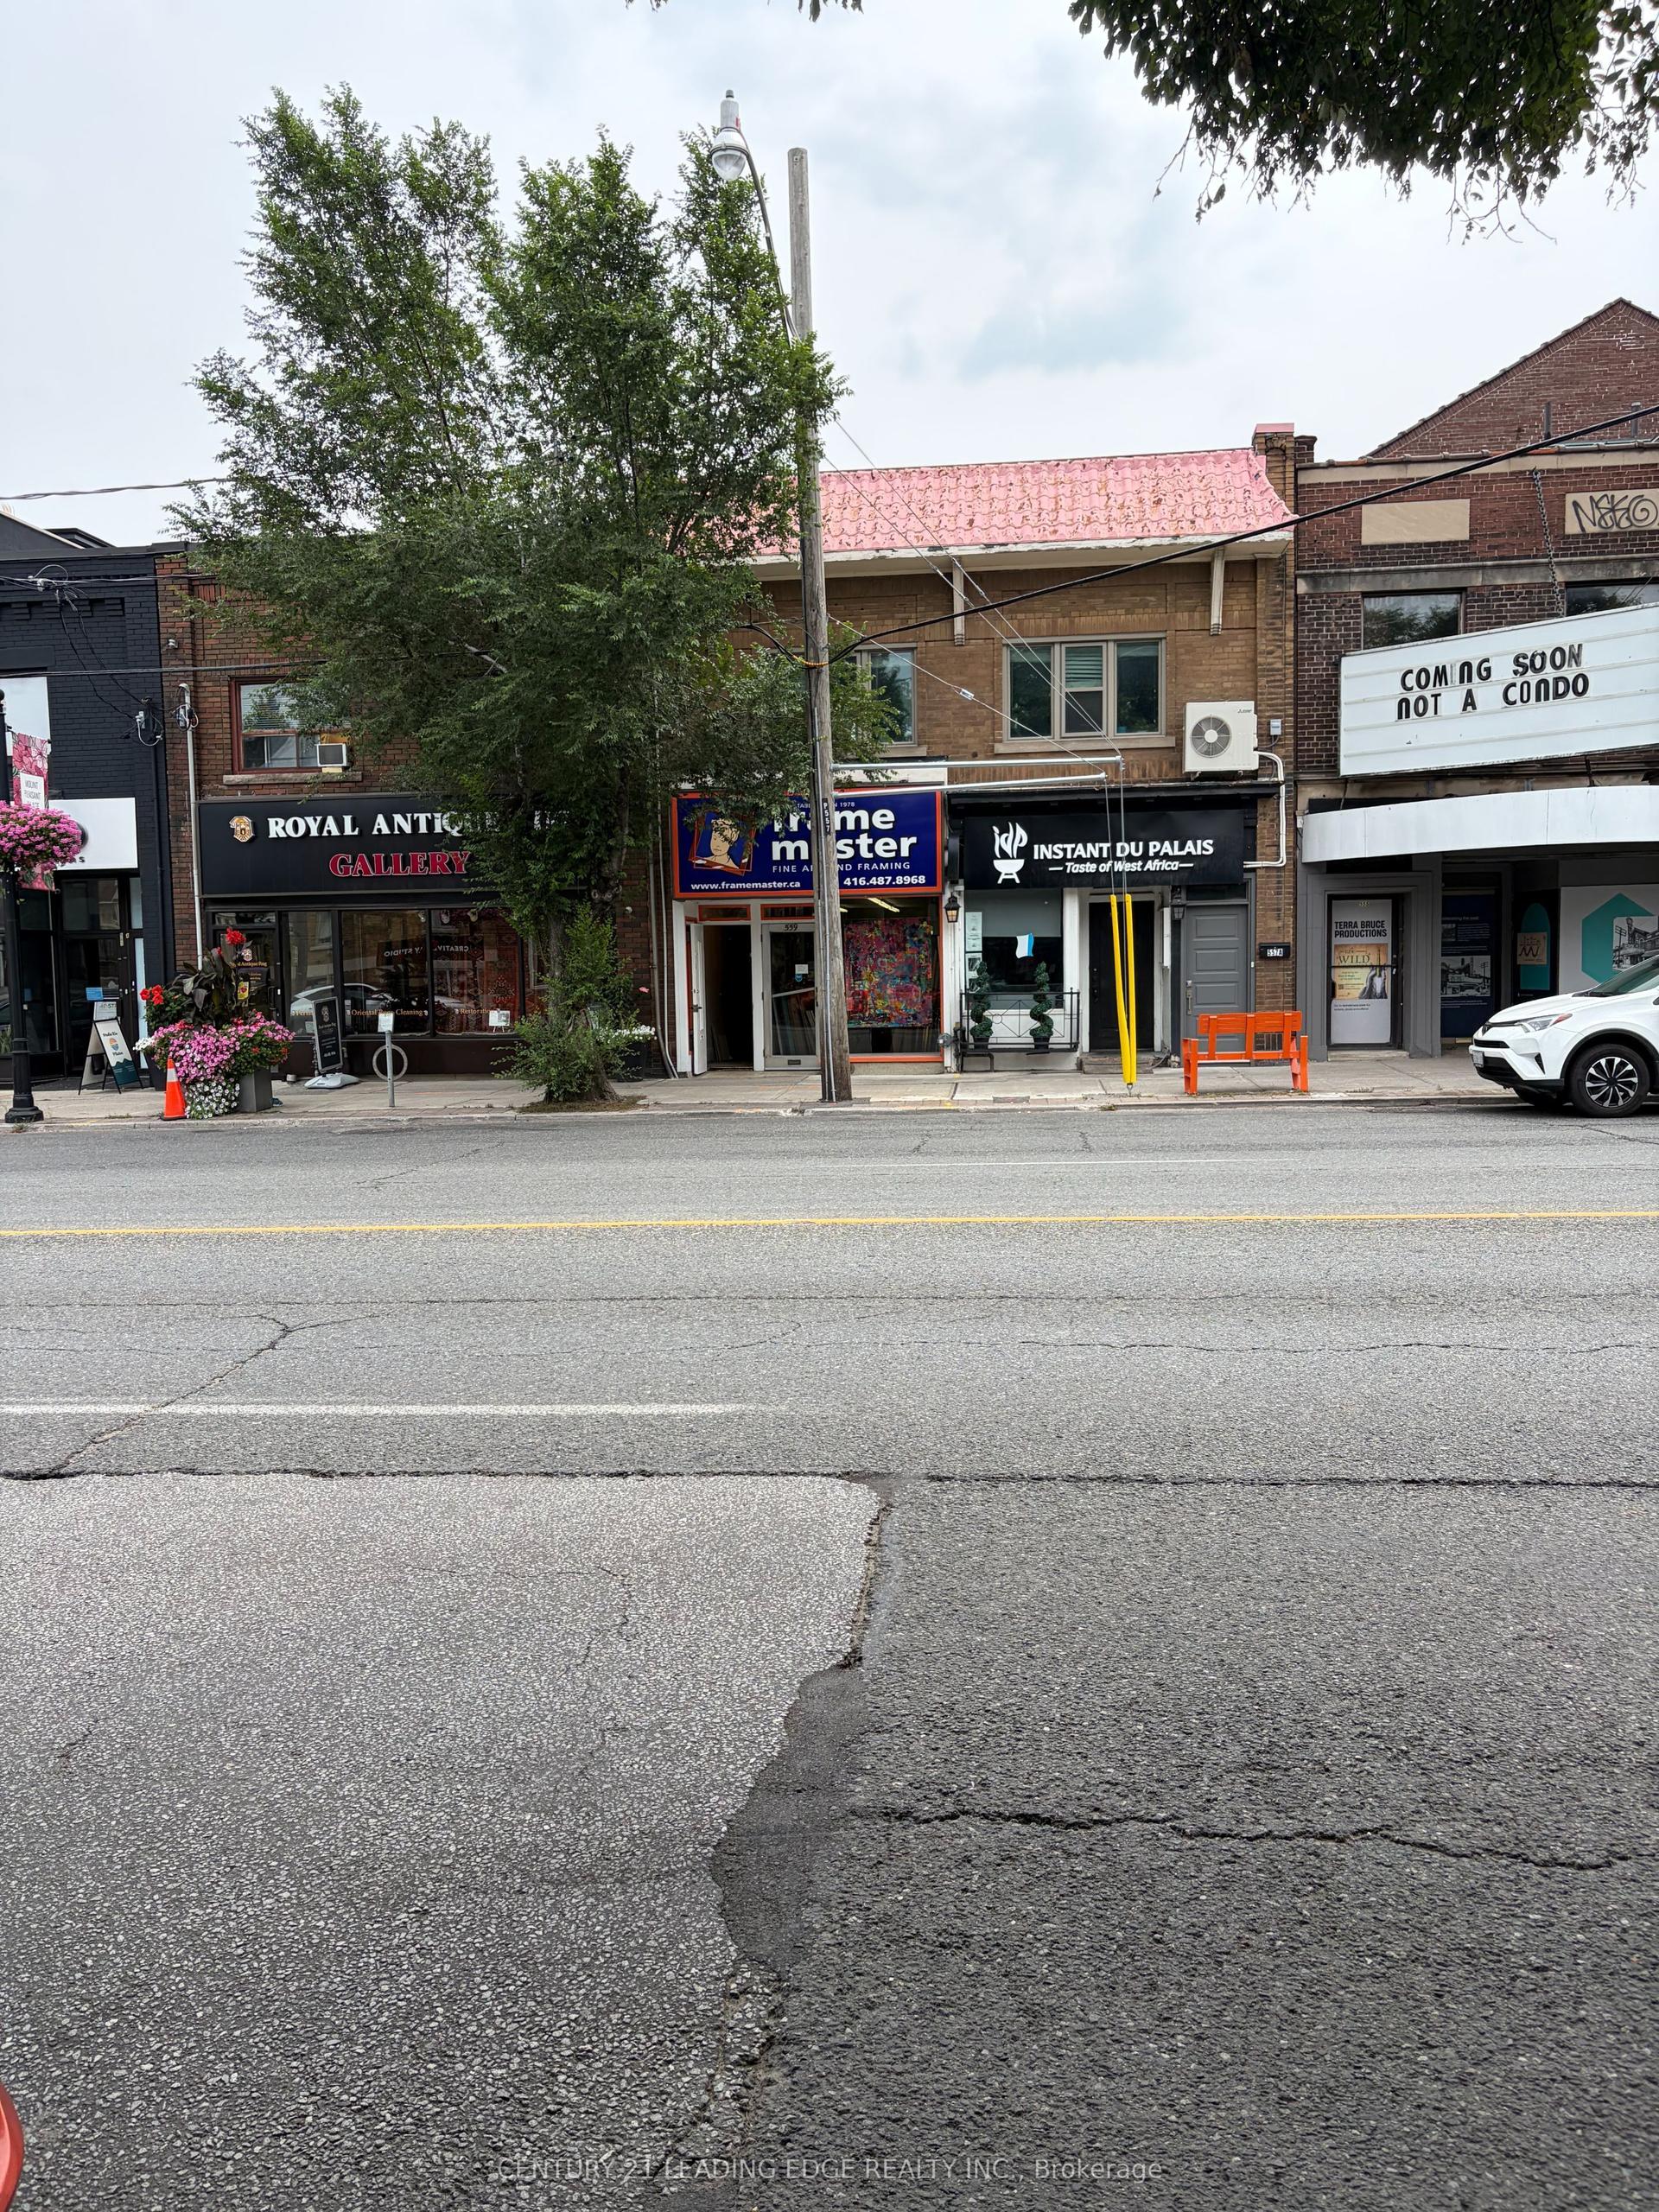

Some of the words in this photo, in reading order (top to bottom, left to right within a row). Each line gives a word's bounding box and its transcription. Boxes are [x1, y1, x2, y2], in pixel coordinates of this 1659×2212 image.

[1401, 658, 1491, 691] COMING
[1512, 644, 1583, 677] SOON
[1397, 693, 1441, 720] NOT
[1462, 689, 1477, 712] A
[1503, 673, 1589, 706] CONDO
[267, 815, 359, 838] ROYAL
[372, 811, 499, 837] ANTIQ
[772, 808, 895, 833] rme
[772, 832, 918, 861] mster
[1033, 842, 1111, 860] INSTANT
[1116, 842, 1143, 858] DU
[1148, 839, 1214, 856] PALAIS
[329, 850, 470, 877] GALLERY
[857, 862, 911, 871] FRAMING
[1065, 861, 1096, 874] Taste
[1099, 861, 1113, 873] of
[1114, 861, 1143, 873] West
[1144, 859, 1179, 872] Africa
[690, 880, 801, 890] www.framemaster.ca
[843, 875, 926, 887] 416.487.8968
[1334, 921, 1358, 930] TERRA
[1360, 920, 1385, 929] BRUCE
[1334, 929, 1388, 938] PRODUCTIONS
[1338, 954, 1370, 964] WILD
